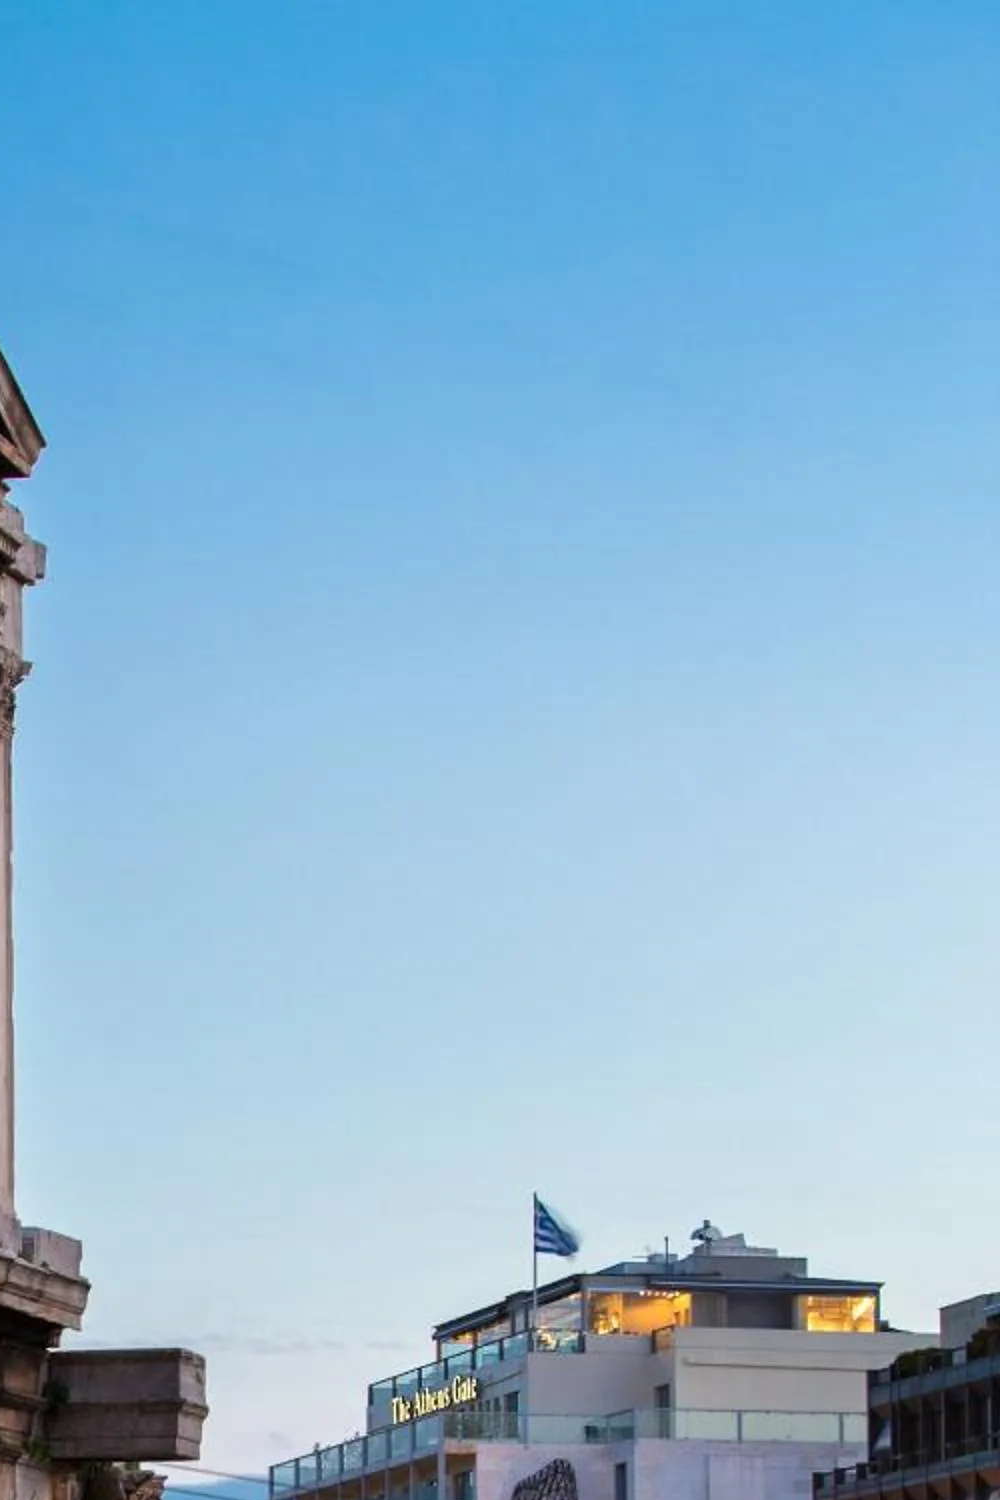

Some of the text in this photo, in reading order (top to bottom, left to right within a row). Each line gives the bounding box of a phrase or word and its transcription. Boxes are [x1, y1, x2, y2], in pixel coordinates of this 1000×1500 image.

[391, 1375, 477, 1424] The Athens Gate
